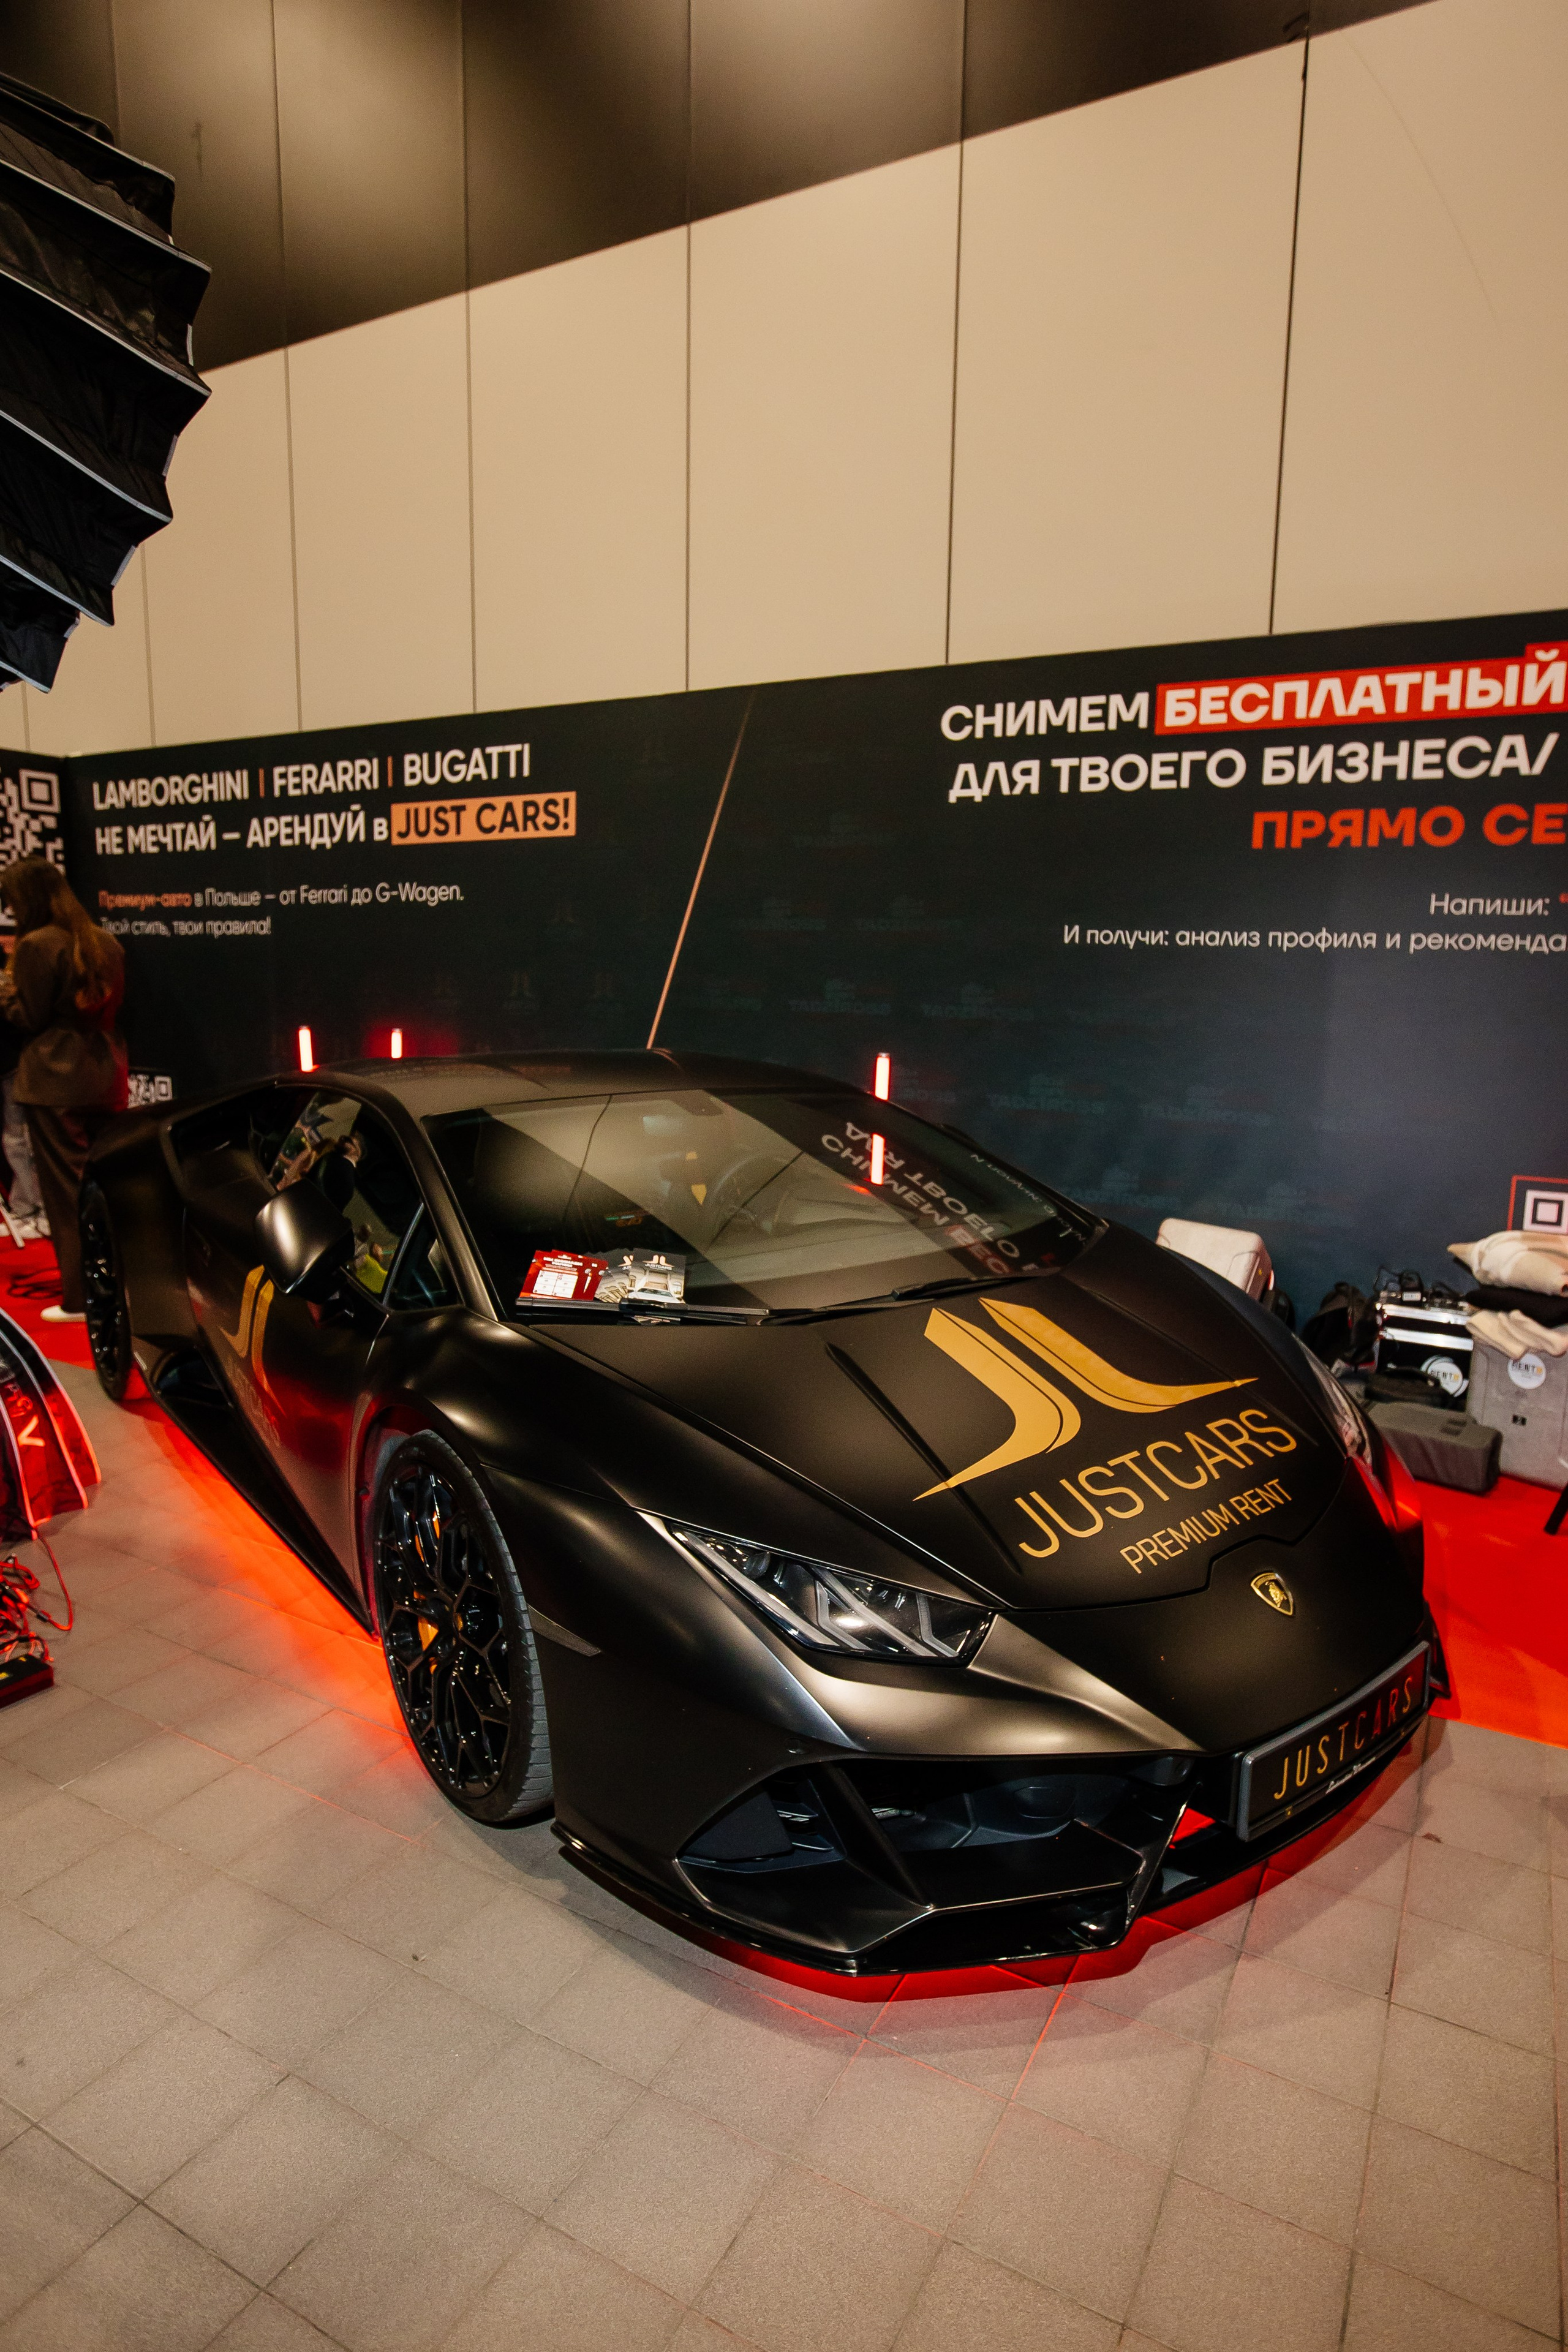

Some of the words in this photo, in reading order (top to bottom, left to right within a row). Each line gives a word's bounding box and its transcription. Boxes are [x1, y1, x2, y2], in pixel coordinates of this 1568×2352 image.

[941, 692, 1149, 740] СНИМЕМ
[1163, 648, 1567, 728] БЕСПЛАТНЫЙ
[92, 769, 249, 811] LAMBORGHINI
[273, 757, 379, 797] FERARRI
[404, 743, 530, 786] BUGATTI
[948, 760, 1040, 803] ДЛЯ
[1051, 749, 1246, 793] ТВОЕГО
[96, 826, 123, 854] НЕ
[127, 815, 216, 853] МЕЧТАЙ
[247, 804, 366, 850] АРЕНДУЙ
[397, 804, 466, 839] JUST
[475, 797, 570, 834] CARS!
[1251, 805, 1465, 849] ПРЯМО
[1483, 803, 1568, 846] СЕ
[205, 887, 262, 907] Польше
[279, 889, 297, 905] от
[300, 883, 348, 905] Ferrari
[351, 888, 372, 906] до
[375, 882, 464, 906] G-Wagen.
[1430, 892, 1550, 916] Напиши:
[1064, 924, 1080, 944] И
[1087, 929, 1169, 949] получи:
[1175, 930, 1261, 948] анализ
[1268, 927, 1377, 952] профиля
[1385, 933, 1401, 949] и
[1409, 932, 1568, 955] рекоменда
[1014, 1409, 1298, 1558] JUSTCARS
[1120, 1504, 1239, 1574] PREMIUM
[1229, 1478, 1292, 1521] RENT
[1273, 1676, 1412, 1800] JUSTCARS
